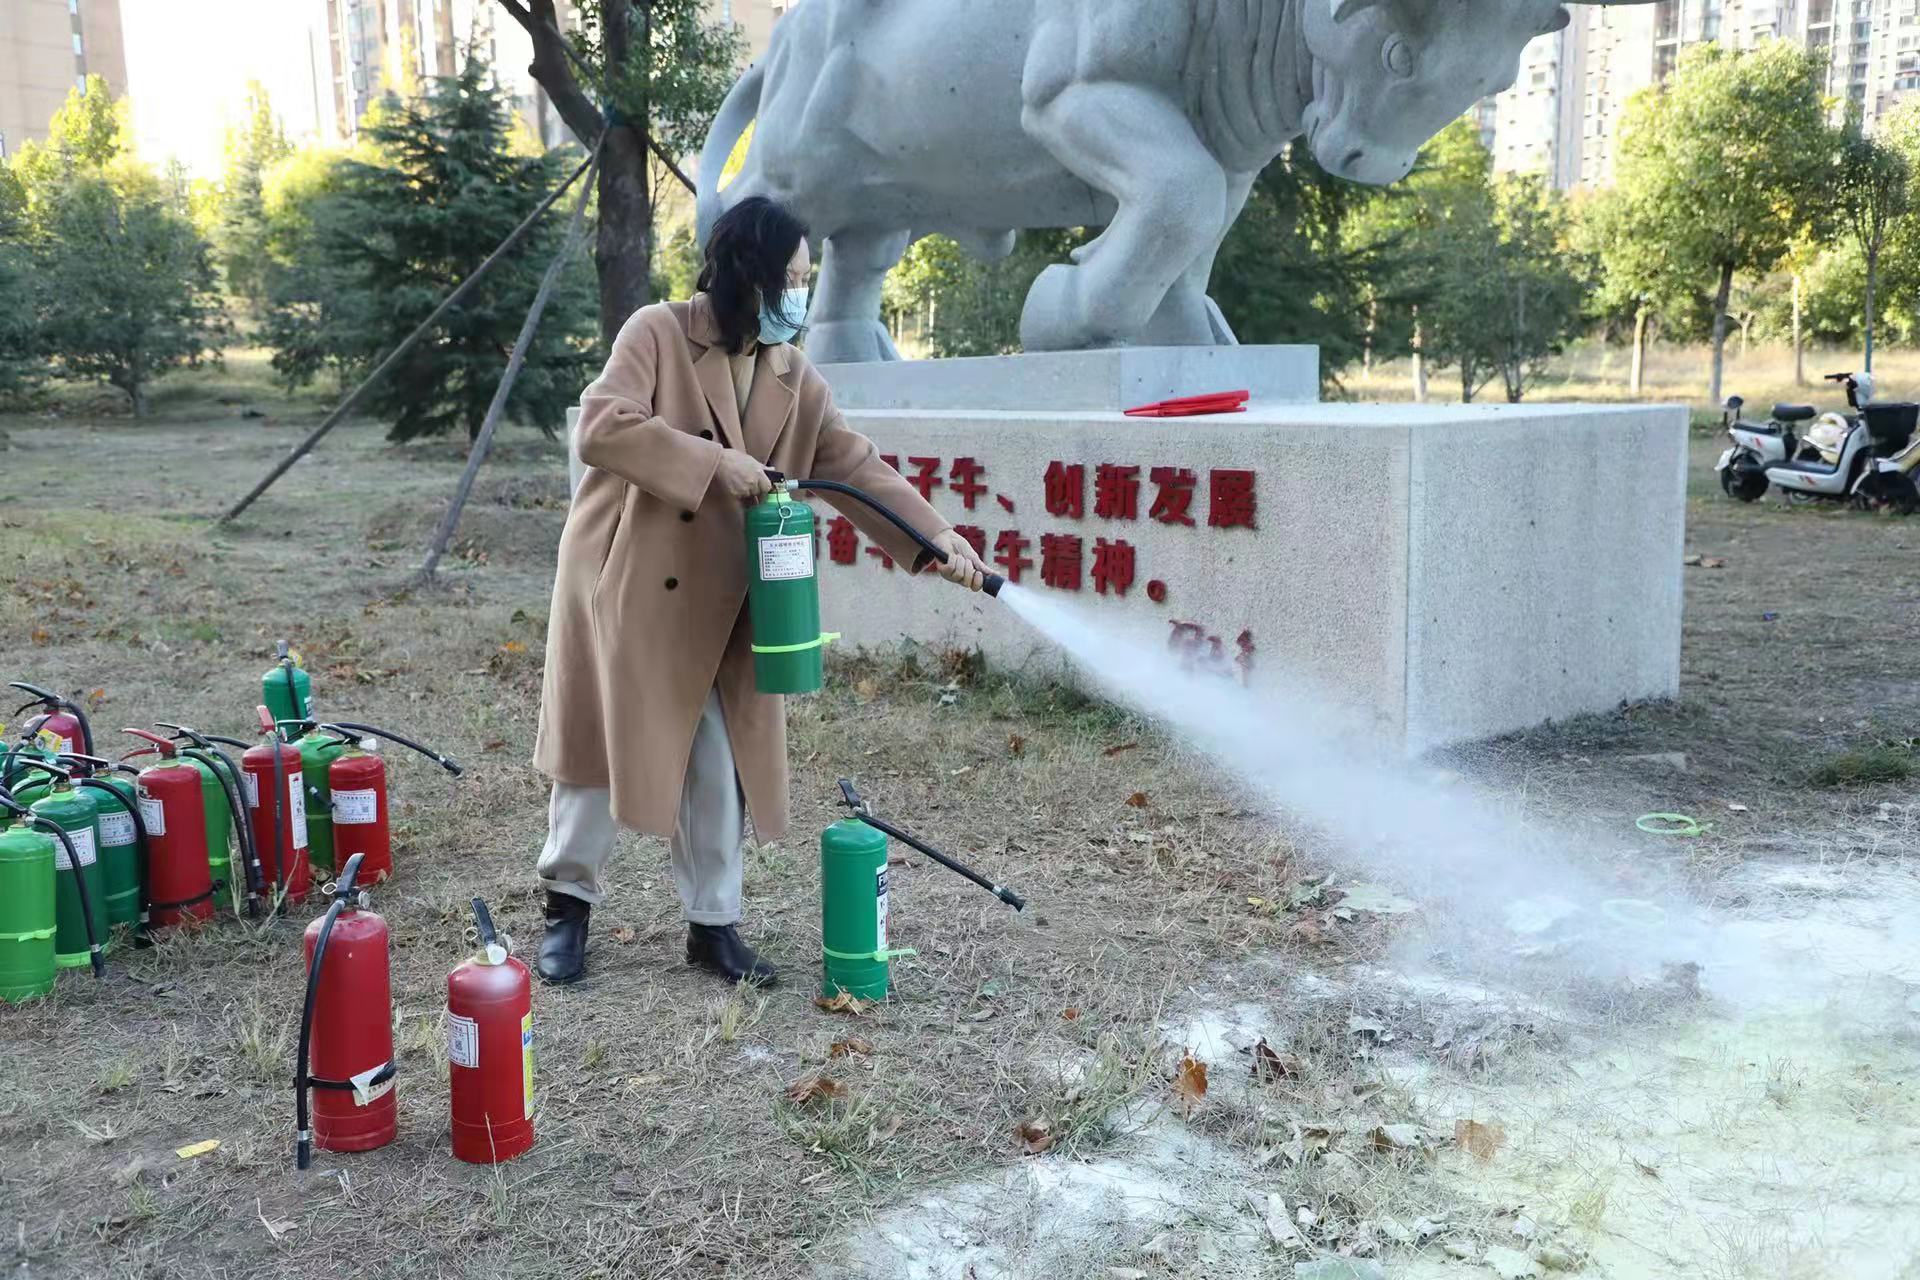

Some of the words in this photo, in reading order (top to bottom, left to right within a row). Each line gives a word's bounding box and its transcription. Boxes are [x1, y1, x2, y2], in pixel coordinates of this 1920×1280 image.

[880, 453, 1257, 529] 子牛、创新发展
